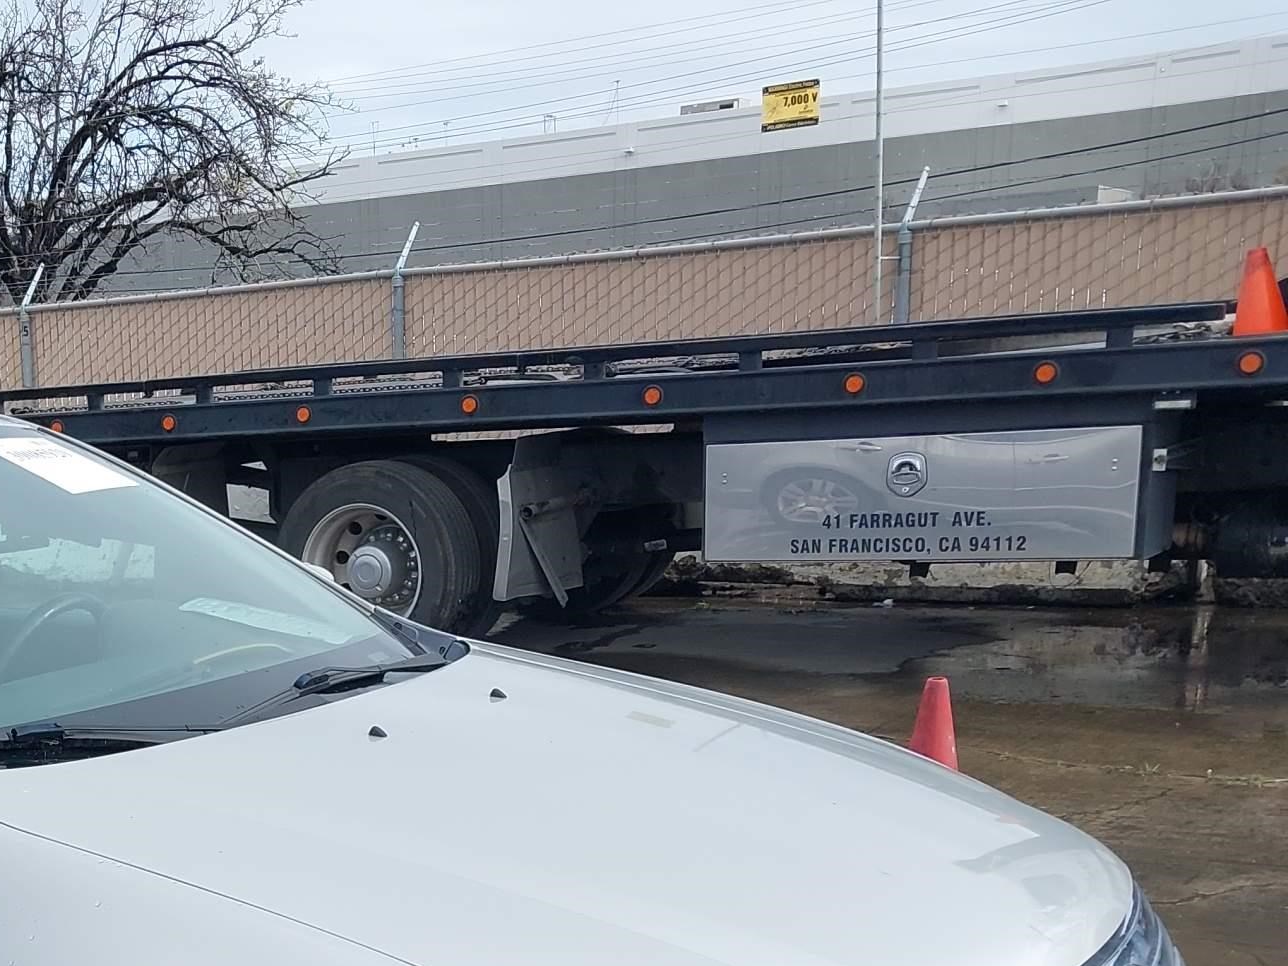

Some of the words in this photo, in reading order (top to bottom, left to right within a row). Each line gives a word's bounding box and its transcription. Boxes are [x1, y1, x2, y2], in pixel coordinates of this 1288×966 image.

[783, 93, 809, 108] 7,000
[811, 92, 818, 102] V
[822, 514, 841, 529] 41
[849, 511, 940, 529] FARRAGUT
[951, 510, 992, 527] AVE.
[790, 538, 822, 554] SAN
[828, 536, 931, 555] FRANCISCO,
[938, 536, 962, 553] CA
[969, 535, 1027, 552] 94112
